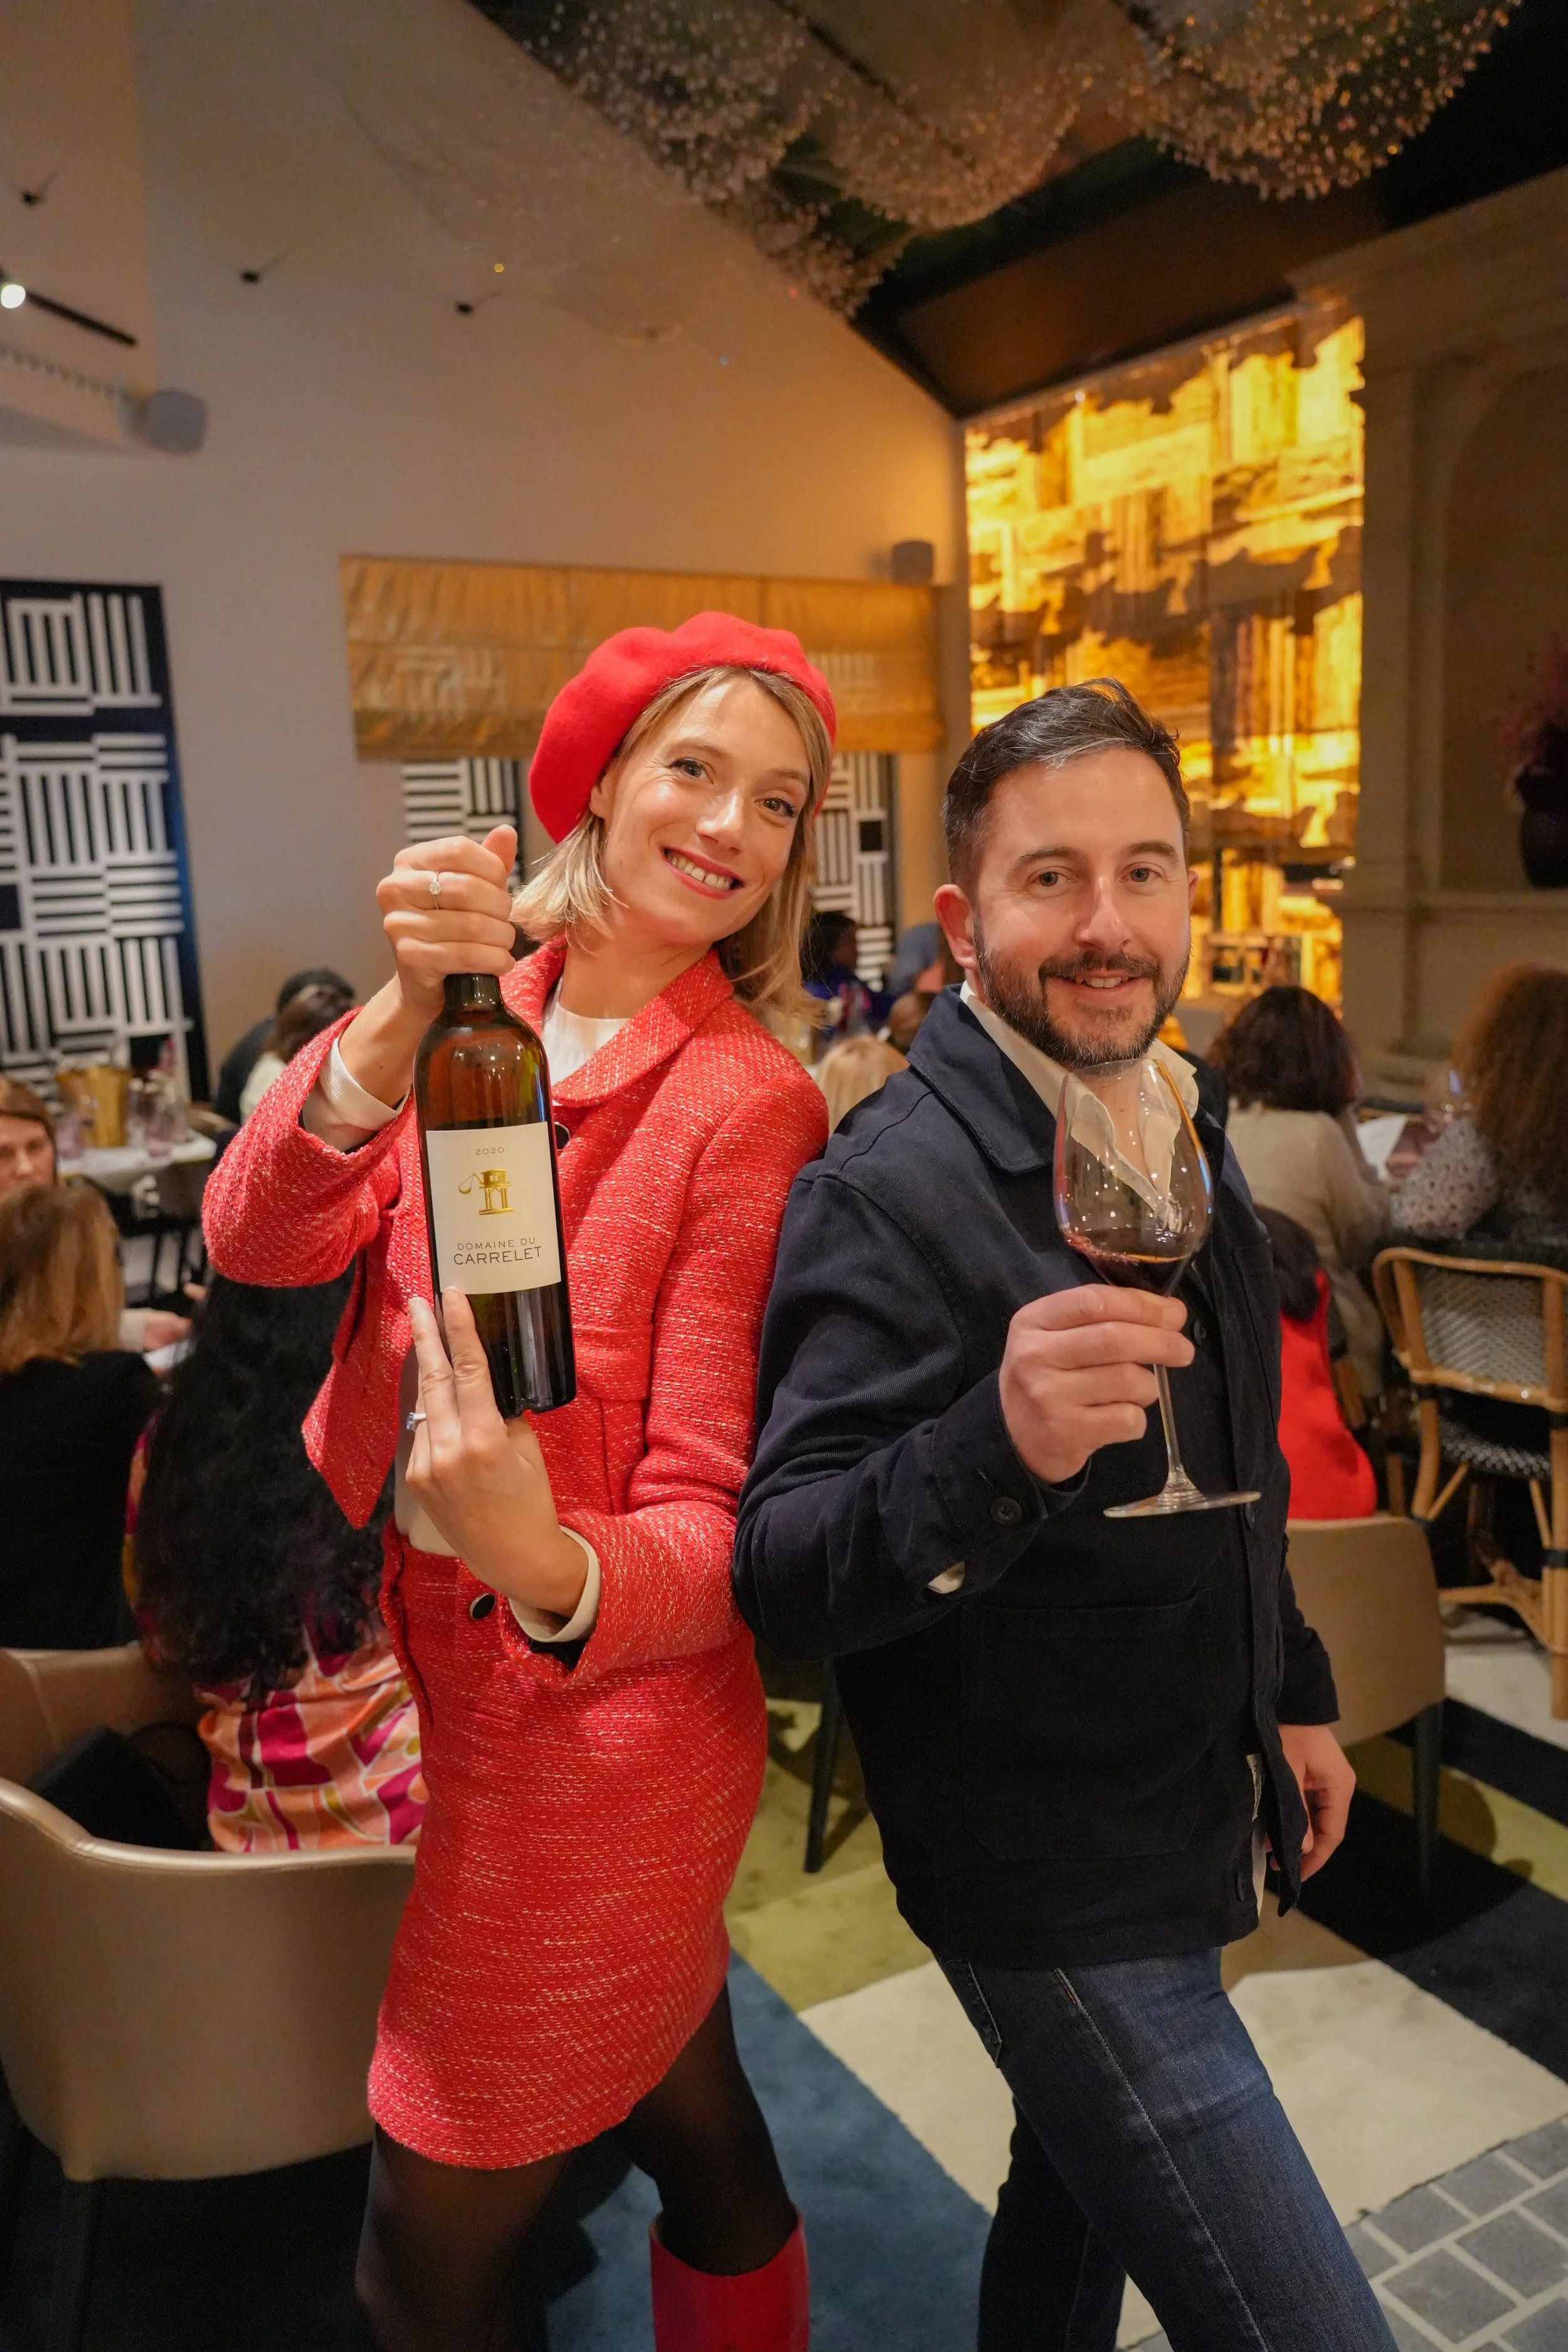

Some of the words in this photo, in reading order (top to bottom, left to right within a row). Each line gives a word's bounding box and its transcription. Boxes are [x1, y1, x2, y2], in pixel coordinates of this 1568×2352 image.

[475, 1147, 505, 1155] 2020
[458, 1239, 514, 1250] DOMAINE
[521, 1236, 535, 1246] DU
[453, 1246, 542, 1265] CARRELET
